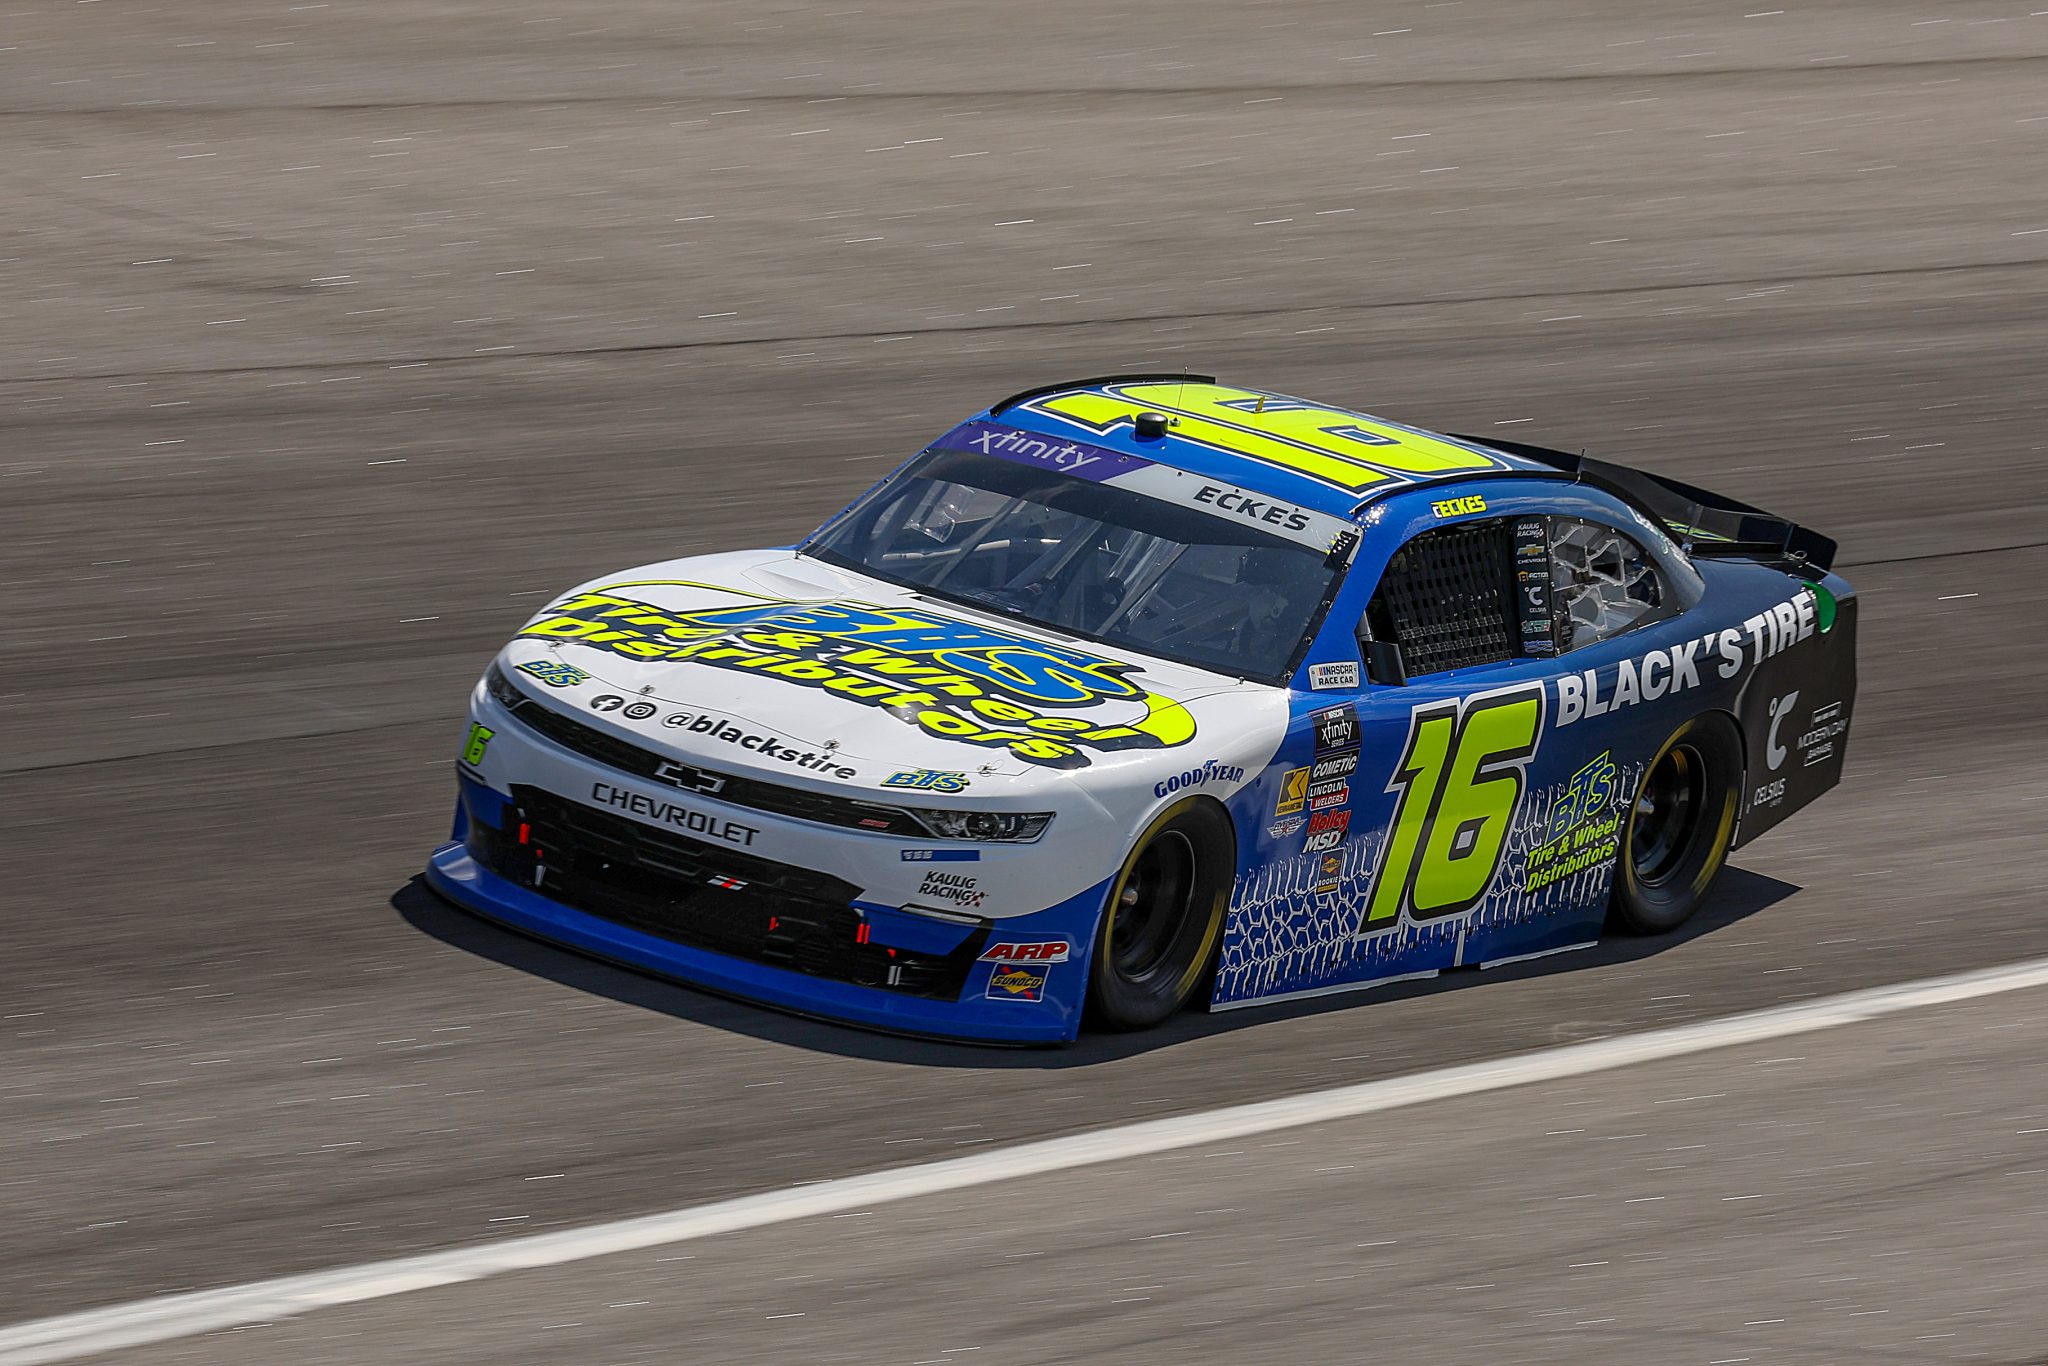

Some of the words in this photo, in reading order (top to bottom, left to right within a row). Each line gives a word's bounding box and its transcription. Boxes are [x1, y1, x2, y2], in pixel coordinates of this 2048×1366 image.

[968, 430, 1102, 472] xfinity
[1026, 383, 1503, 496] 16
[1193, 485, 1311, 531] ECKES
[556, 593, 728, 639] Tire
[742, 631, 823, 652] &
[839, 647, 1142, 741] Wheel
[1325, 664, 1353, 676] NASCAR
[1556, 628, 1744, 729] BLACK'S
[1743, 590, 1816, 666] TIRE
[518, 616, 1076, 760] Distributors
[1318, 676, 1339, 686] RACE
[1340, 675, 1354, 684] CAR
[463, 721, 496, 767] 16
[1321, 719, 1353, 745] xfinity
[1331, 738, 1345, 748] SERIES
[662, 711, 857, 780] @blackstire
[1312, 755, 1358, 778] COMETIC
[882, 769, 967, 792] BTS
[1309, 781, 1343, 797] LINCOLN
[1754, 778, 1786, 806] CELSIUS
[1314, 793, 1344, 807] WELDERS
[1364, 686, 1543, 929] 16
[592, 782, 761, 846] CHEVROLET
[1307, 809, 1352, 833] Holley
[1302, 831, 1342, 853] MSD
[1527, 845, 1555, 870] Tire
[1557, 835, 1570, 856] &
[1573, 812, 1621, 849] Wheel
[1525, 840, 1616, 893] Distributors
[918, 882, 973, 901] RACING
[924, 870, 977, 889] KAULIG
[1318, 877, 1338, 887] ROOKIE
[984, 942, 1068, 960] ARP
[993, 976, 1042, 988] SUNOCO
